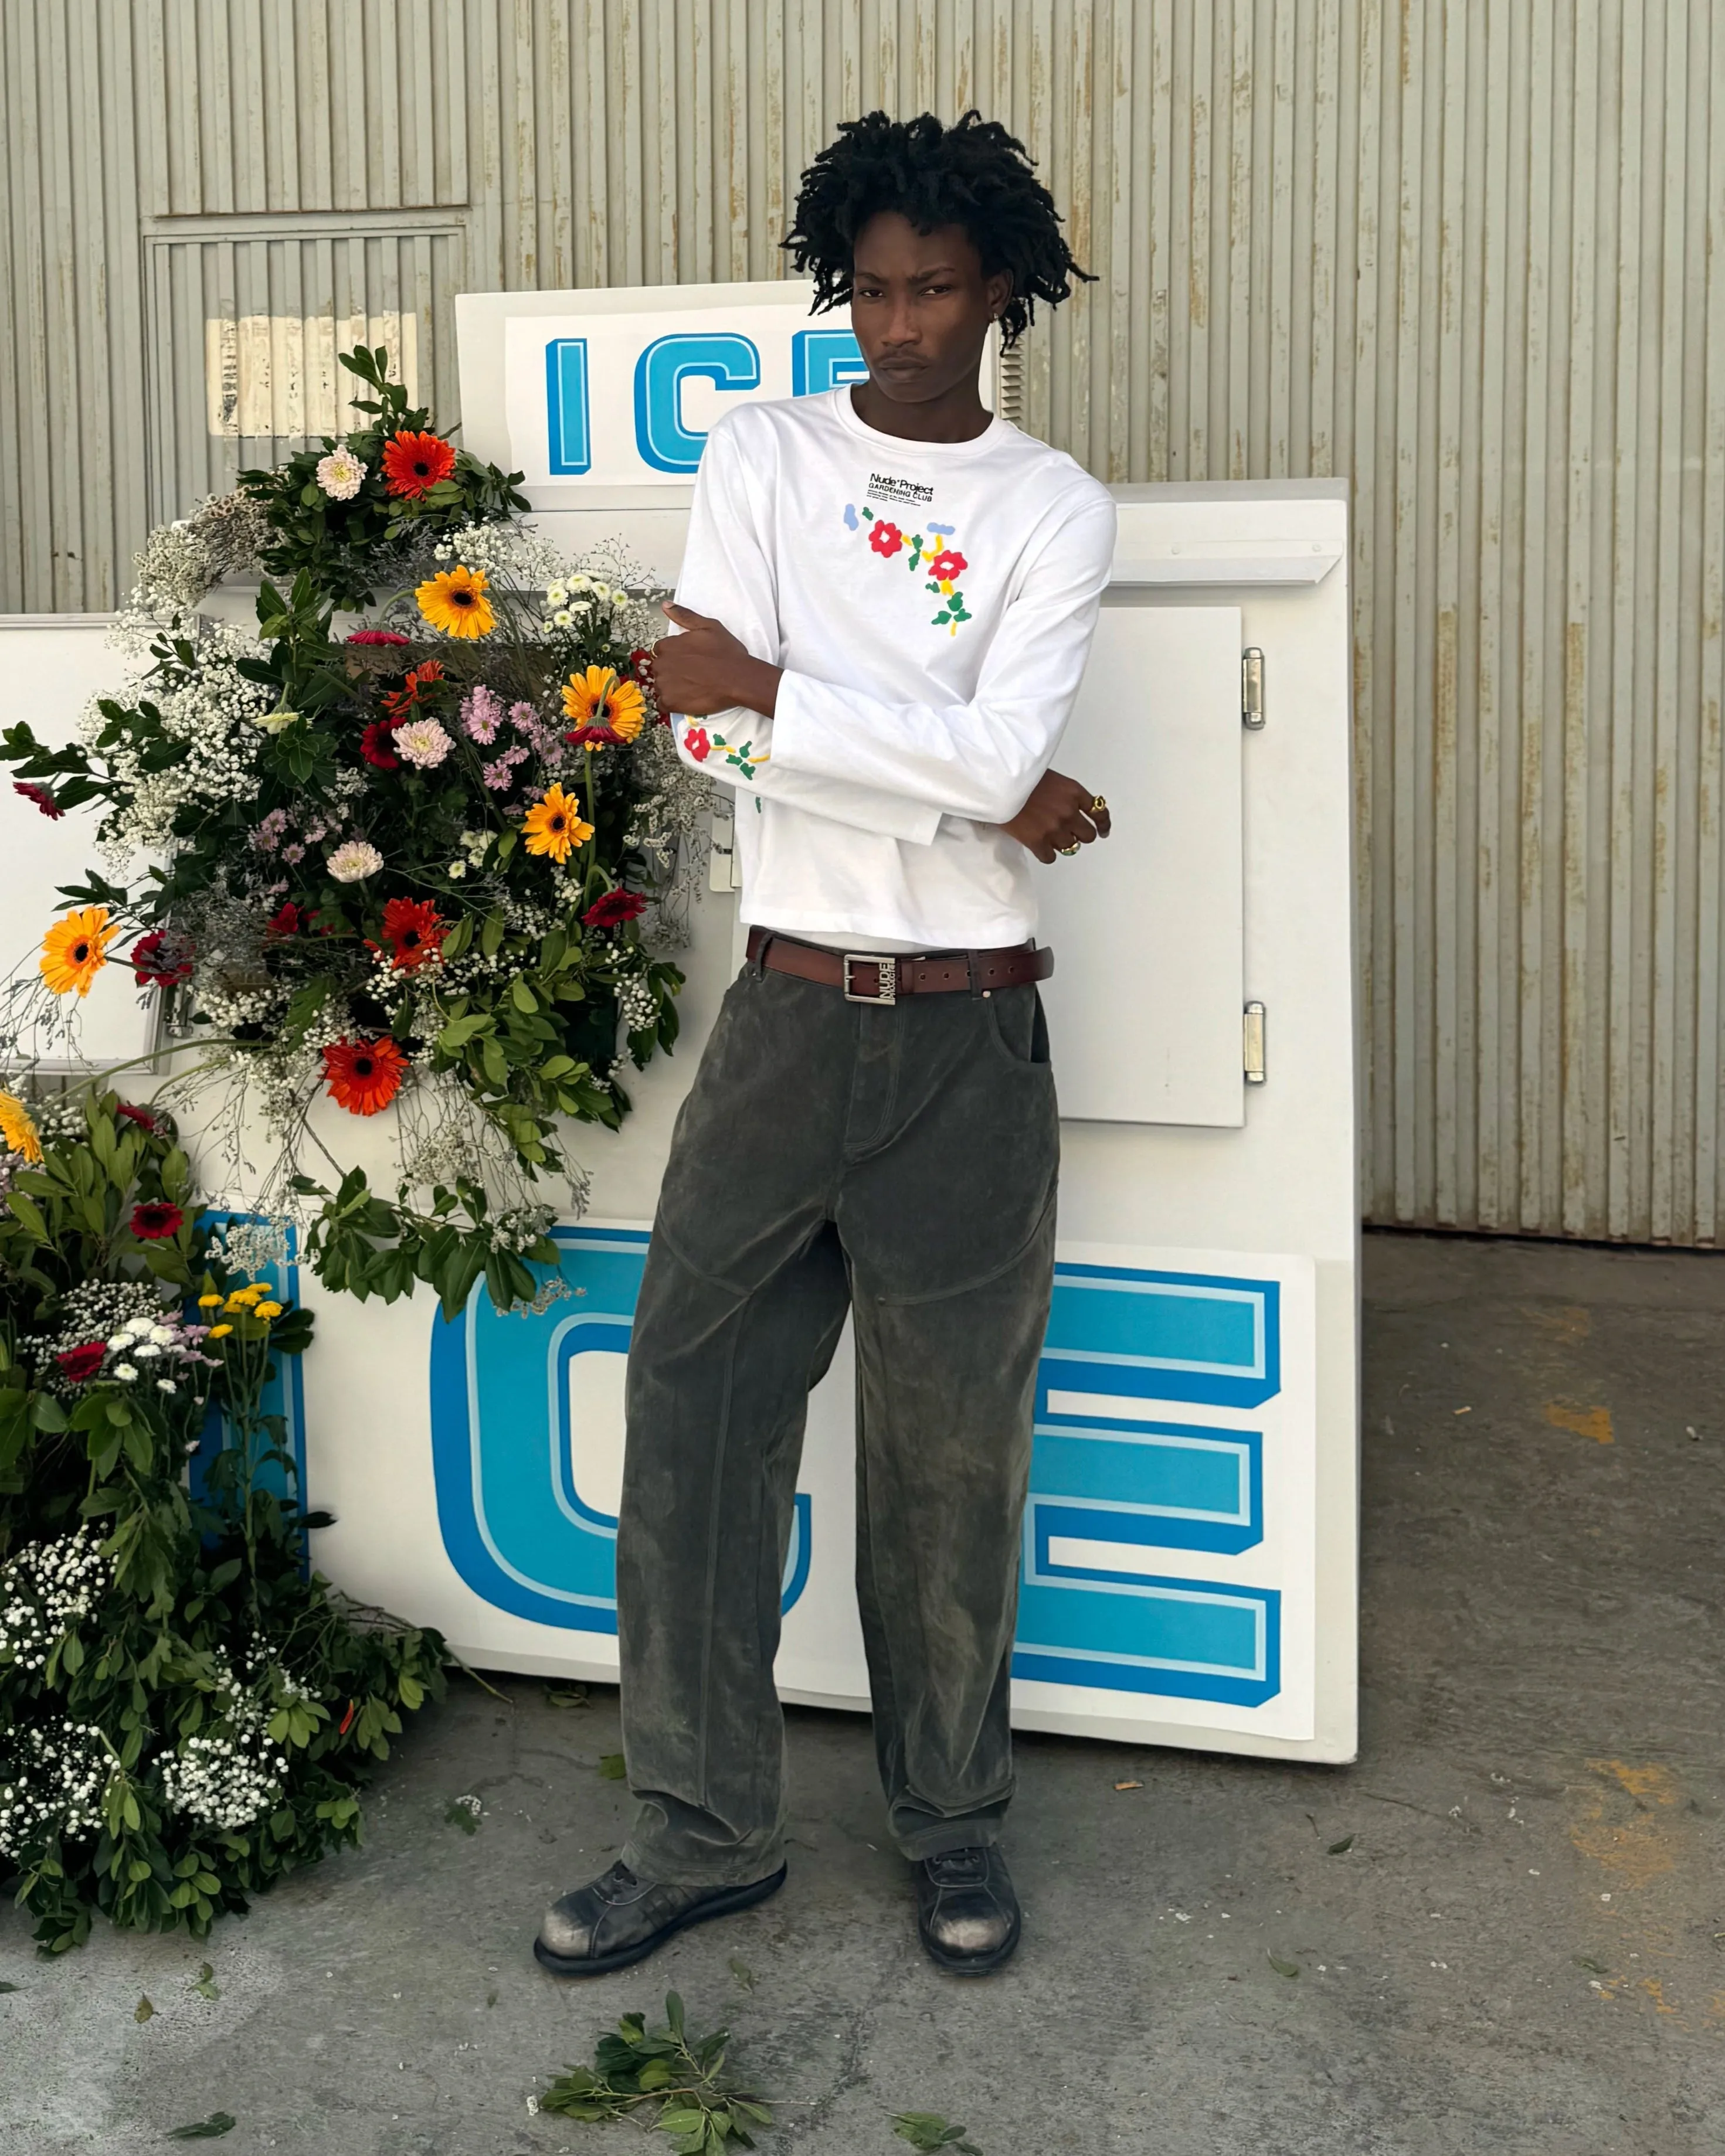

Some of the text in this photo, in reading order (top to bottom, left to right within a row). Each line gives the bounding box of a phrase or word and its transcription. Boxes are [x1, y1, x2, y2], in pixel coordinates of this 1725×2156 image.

[868, 482, 911, 497] GARDENING
[912, 491, 932, 502] CLUB
[879, 963, 890, 999] NUDE
